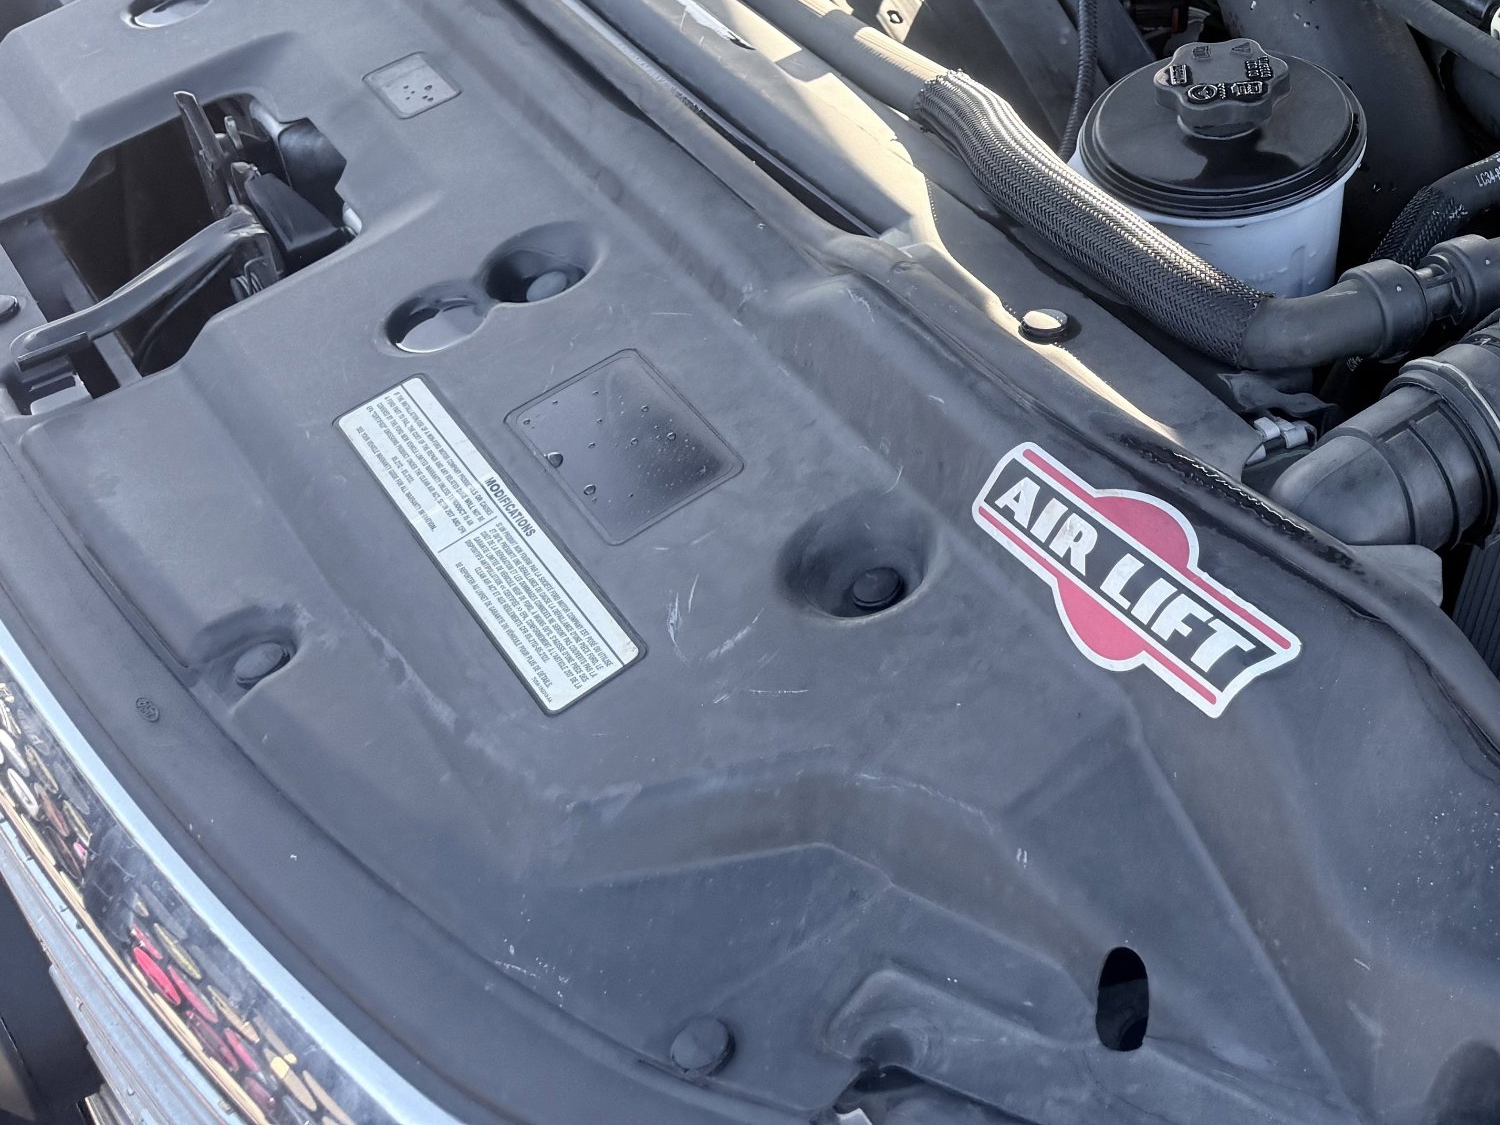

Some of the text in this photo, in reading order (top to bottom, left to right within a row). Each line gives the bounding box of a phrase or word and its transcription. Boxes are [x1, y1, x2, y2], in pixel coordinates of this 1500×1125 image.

[482, 475, 537, 537] MODIFICATIONS
[994, 476, 1257, 673] AIR LIFT
